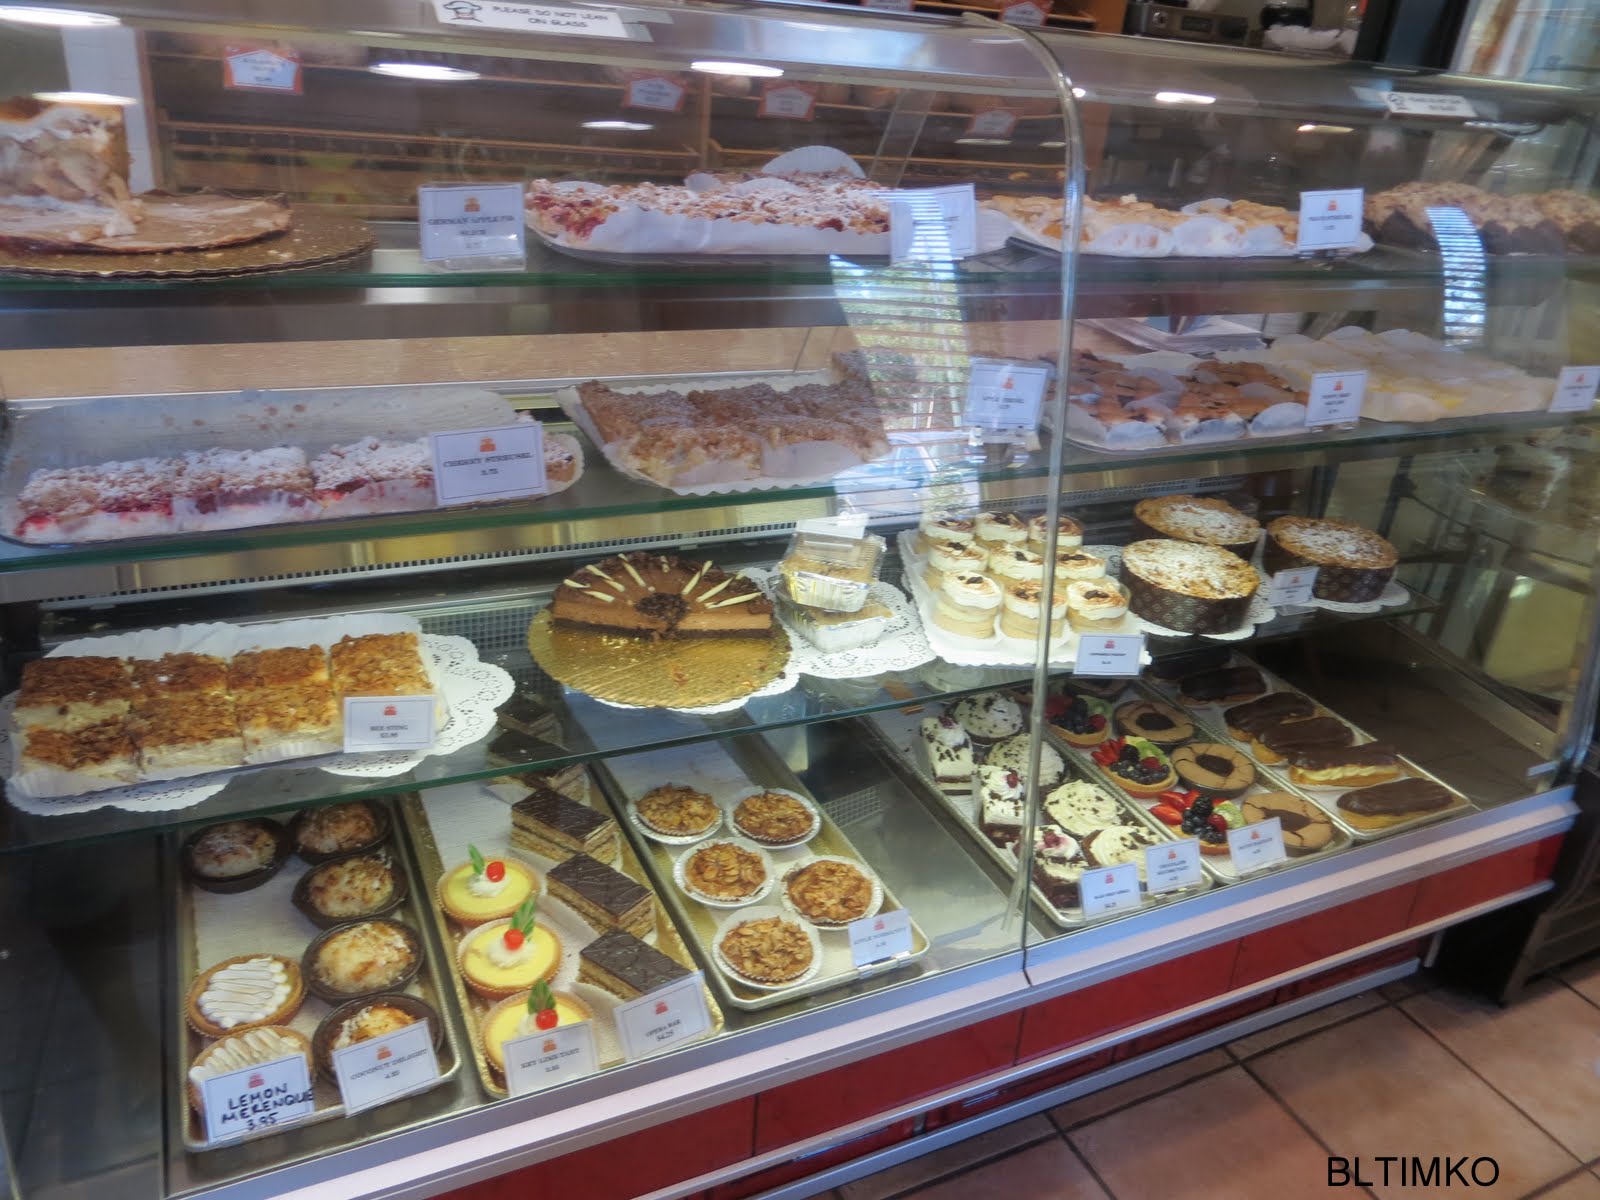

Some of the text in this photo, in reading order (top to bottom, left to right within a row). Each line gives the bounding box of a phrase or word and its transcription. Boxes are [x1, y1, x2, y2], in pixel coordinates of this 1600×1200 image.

[492, 6, 530, 15] PLEASE
[554, 11, 577, 19] NOT
[528, 17, 547, 25] ON
[228, 1082, 288, 1110] LEMON
